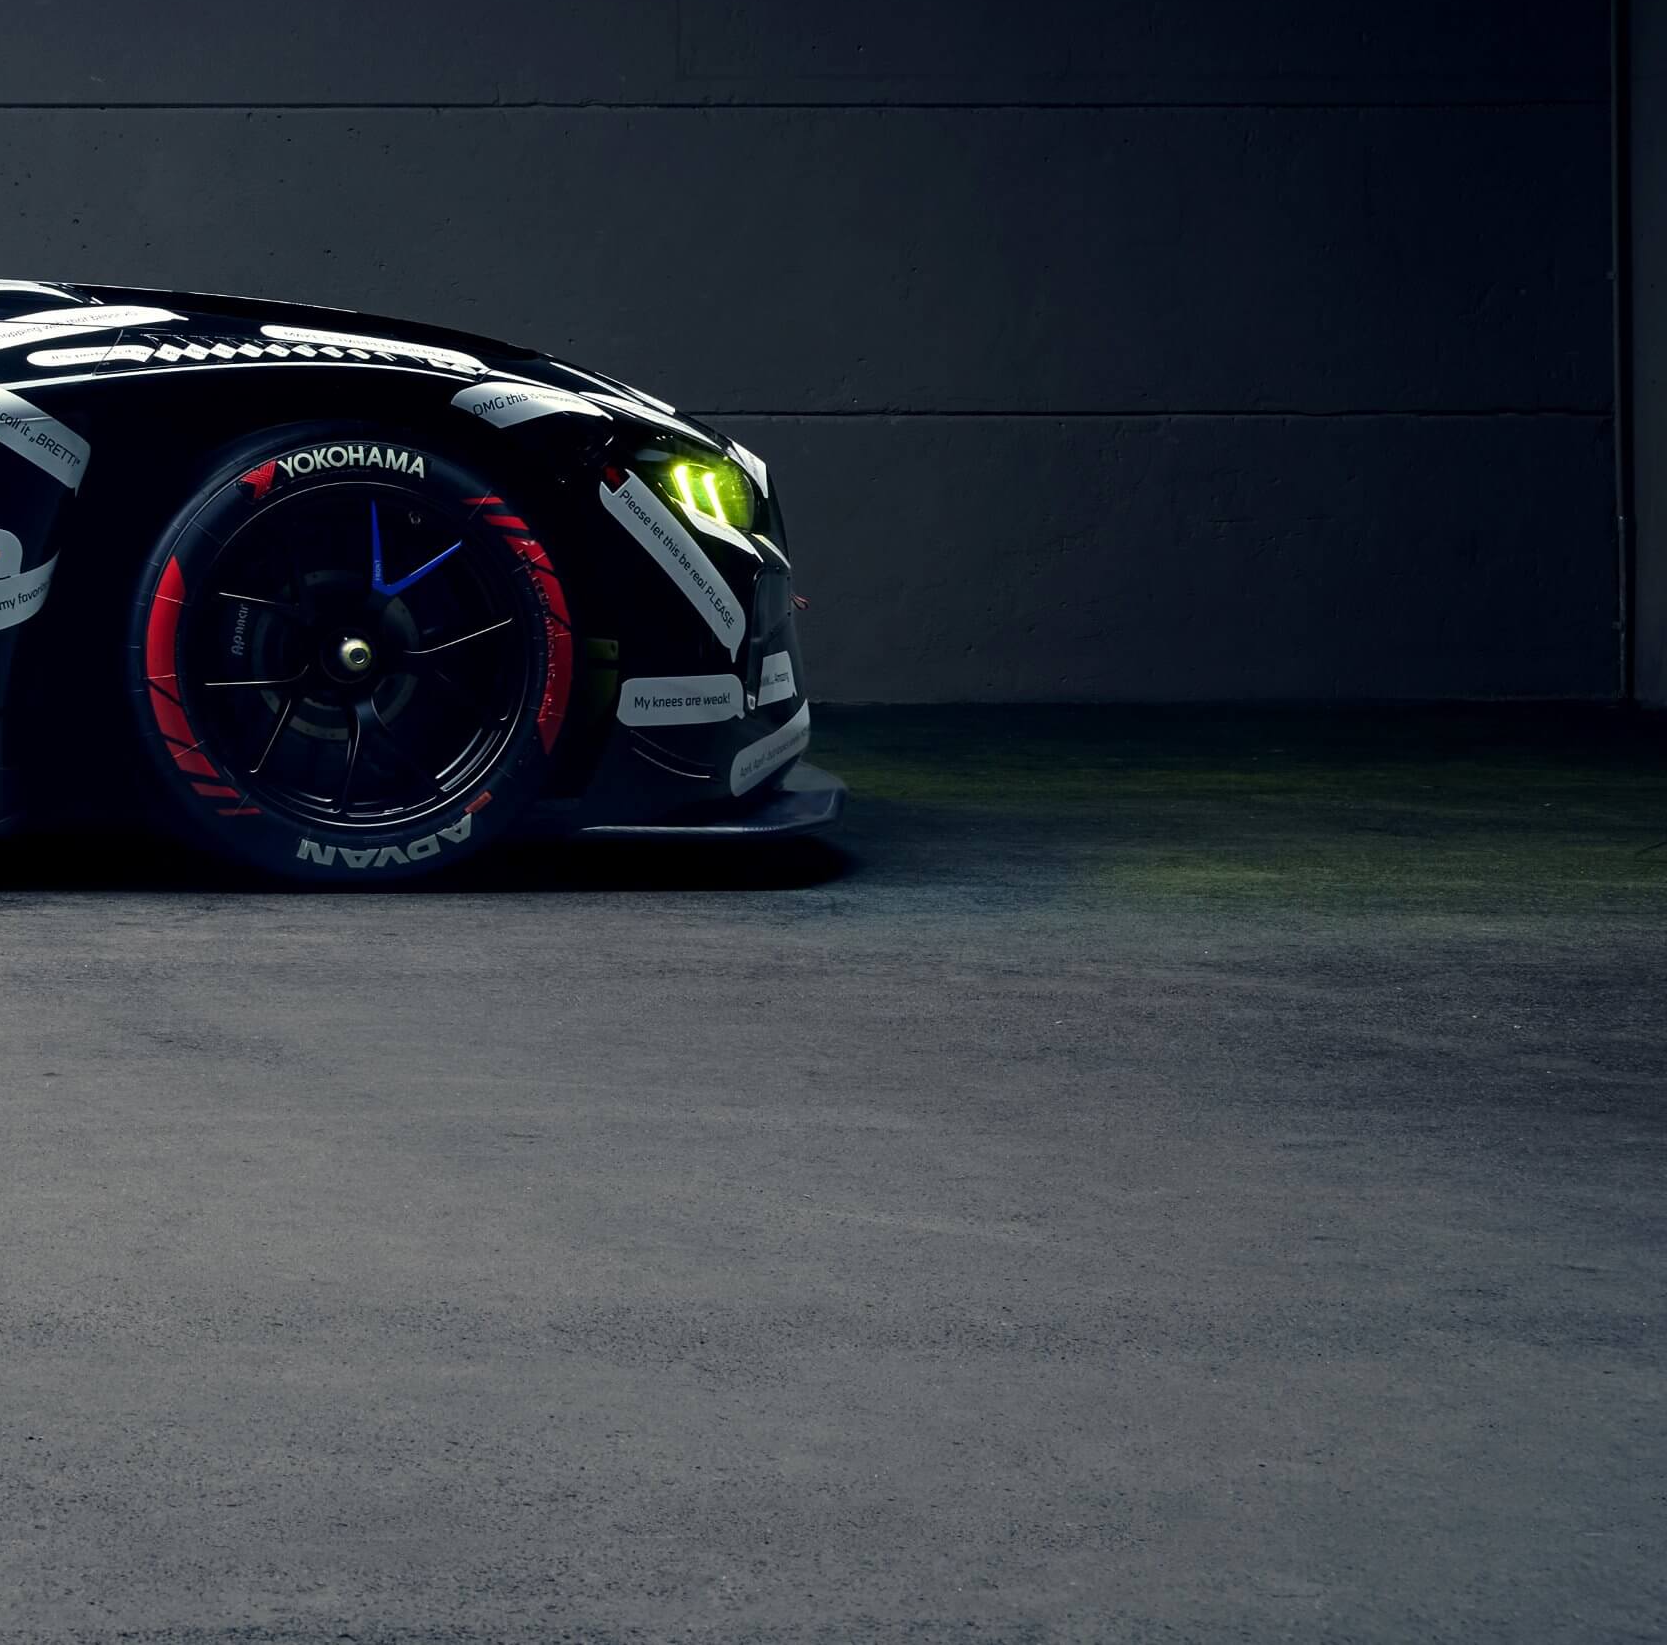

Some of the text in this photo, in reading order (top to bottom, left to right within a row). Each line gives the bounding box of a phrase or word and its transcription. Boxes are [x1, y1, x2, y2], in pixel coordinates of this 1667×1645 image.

[472, 396, 505, 417] OMG
[506, 391, 529, 406] this
[0, 412, 20, 431] call
[20, 421, 29, 437] it
[277, 445, 425, 479] YOKOHAMA
[619, 489, 735, 630] Please let this be real PLEASE
[634, 692, 731, 710] My knees are weak!
[297, 812, 472, 869] ADVAN
